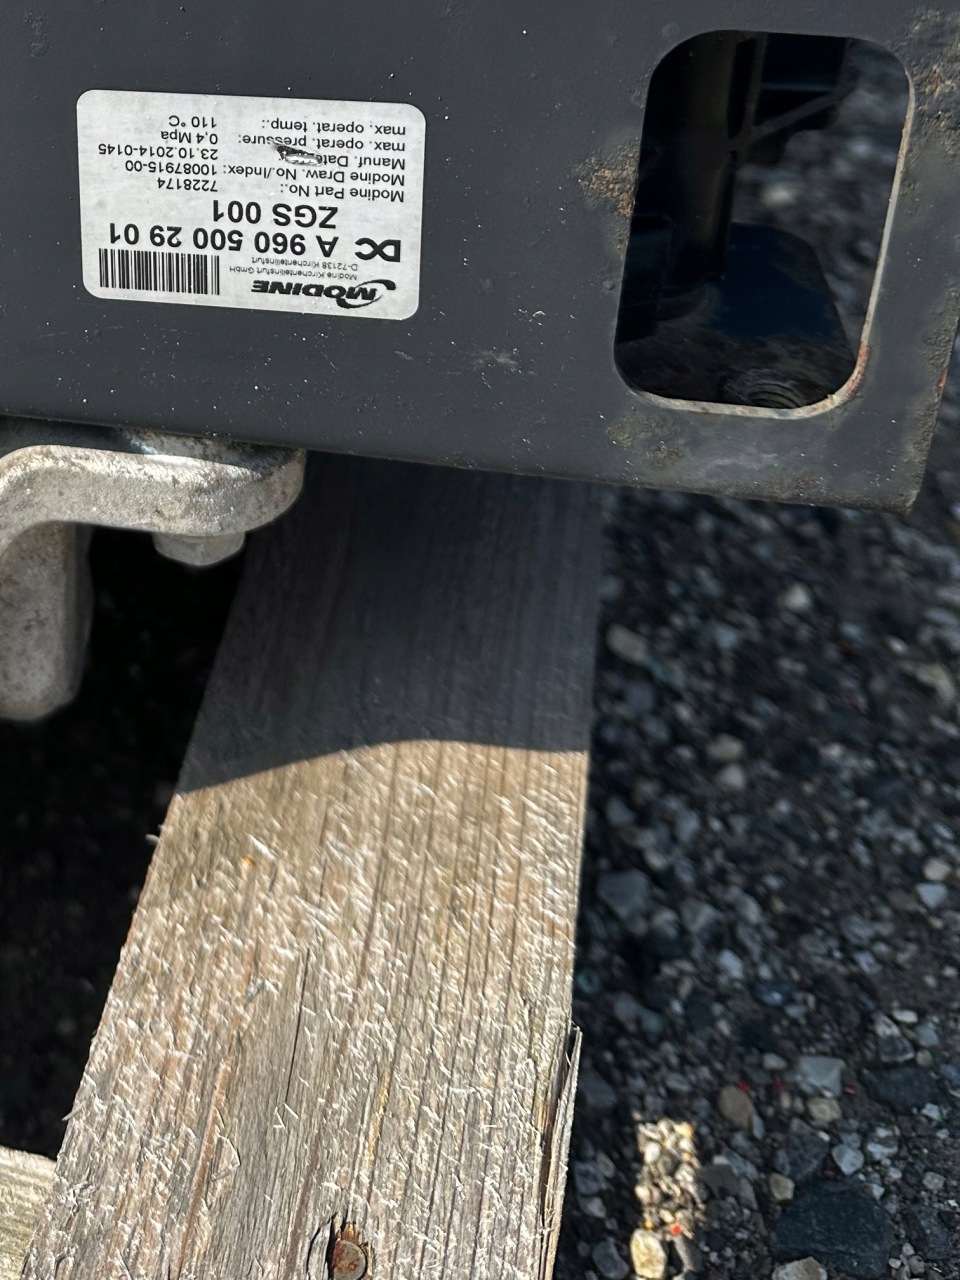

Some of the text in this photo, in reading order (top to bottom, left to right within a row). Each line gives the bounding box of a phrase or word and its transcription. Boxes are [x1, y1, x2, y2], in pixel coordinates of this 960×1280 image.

[169, 115, 405, 136] max. operat. temp.: 110 °C
[161, 129, 405, 152] max. operat. pressure: 0,4 Mpa
[98, 144, 218, 160] 23.10.2014-0145
[126, 160, 404, 186] Modine Draw. No./Index: 10087915-00
[354, 156, 405, 170] Manuf.
[157, 178, 404, 202] Modine Part No.: 7228174
[213, 200, 338, 229] ZGS 001
[110, 223, 401, 262] DC A 960 500 29 01
[230, 265, 254, 273] GmbH
[322, 262, 358, 271] D-72138
[327, 272, 357, 280] Modine
[252, 280, 377, 300] MODINE
